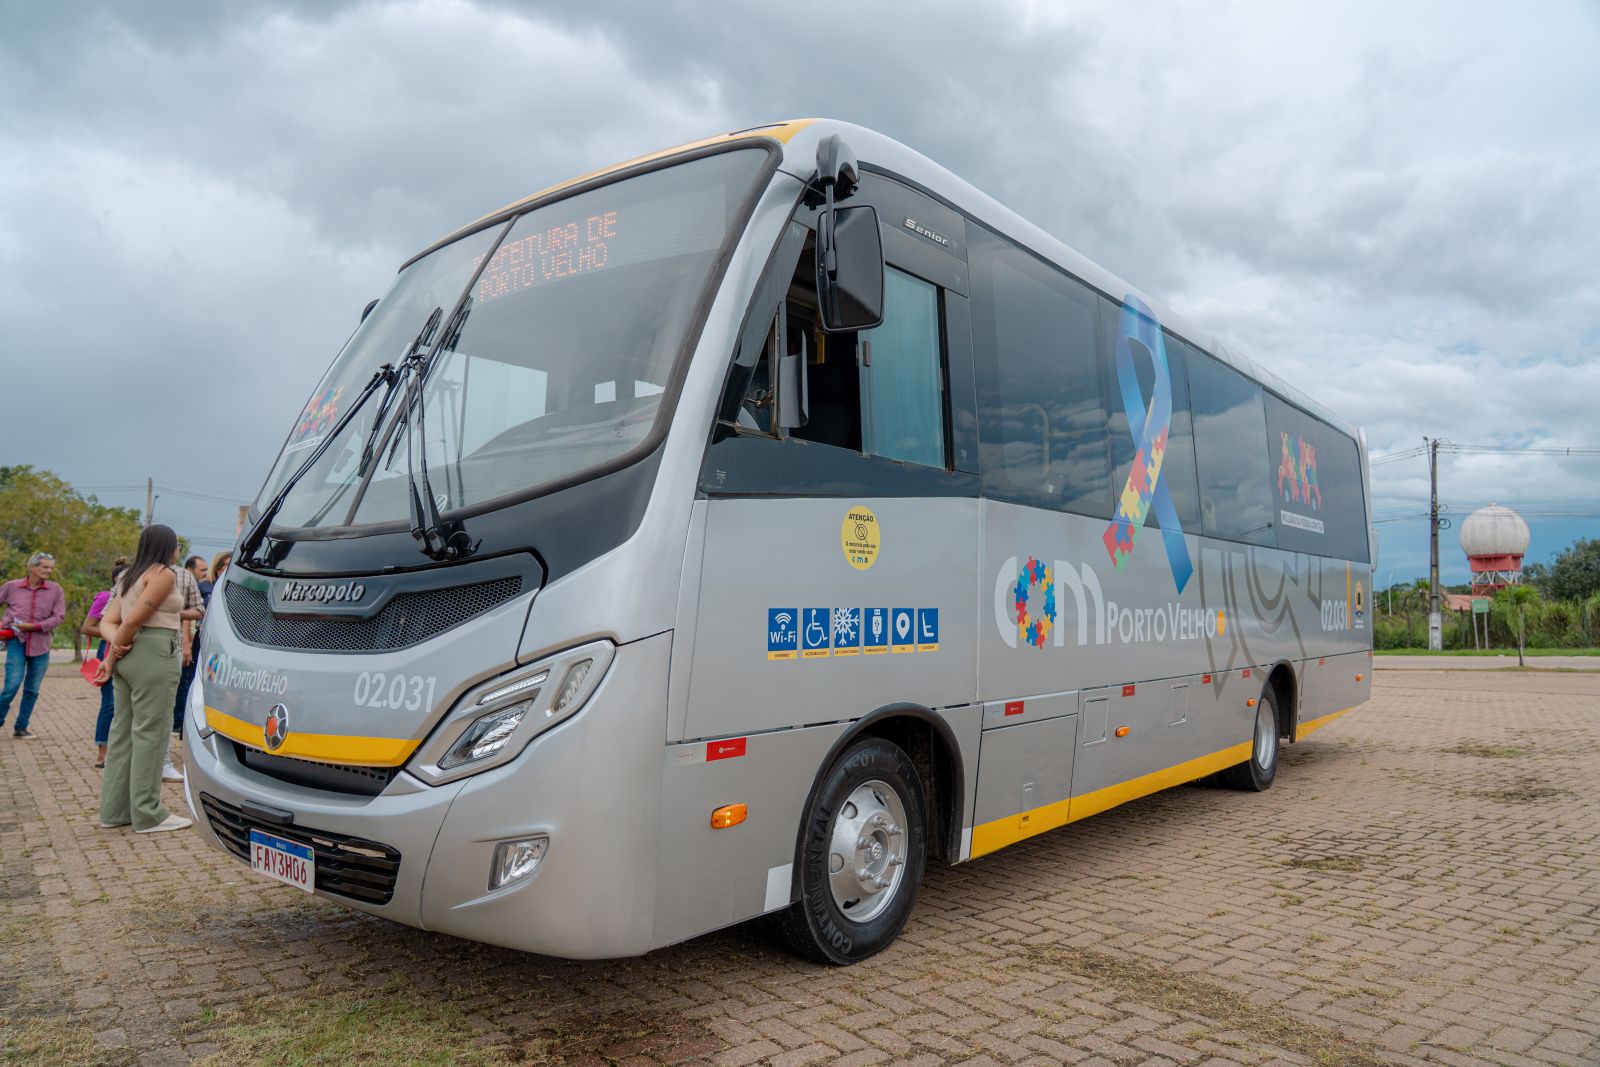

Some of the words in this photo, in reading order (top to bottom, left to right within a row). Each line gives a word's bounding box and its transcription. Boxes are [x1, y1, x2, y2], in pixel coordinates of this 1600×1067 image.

[473, 222, 578, 276] PEFEITURA
[588, 210, 617, 242] DE
[905, 218, 948, 245] Senior
[480, 262, 535, 303] PORTO
[542, 242, 608, 280] VELHO
[848, 512, 874, 522] ATENÇÃO
[281, 580, 366, 604] Marcopolo
[1321, 599, 1348, 631] 02.031
[770, 630, 796, 643] Wi-Fi
[353, 671, 437, 713] 02.031
[256, 845, 307, 885] FAY3H06
